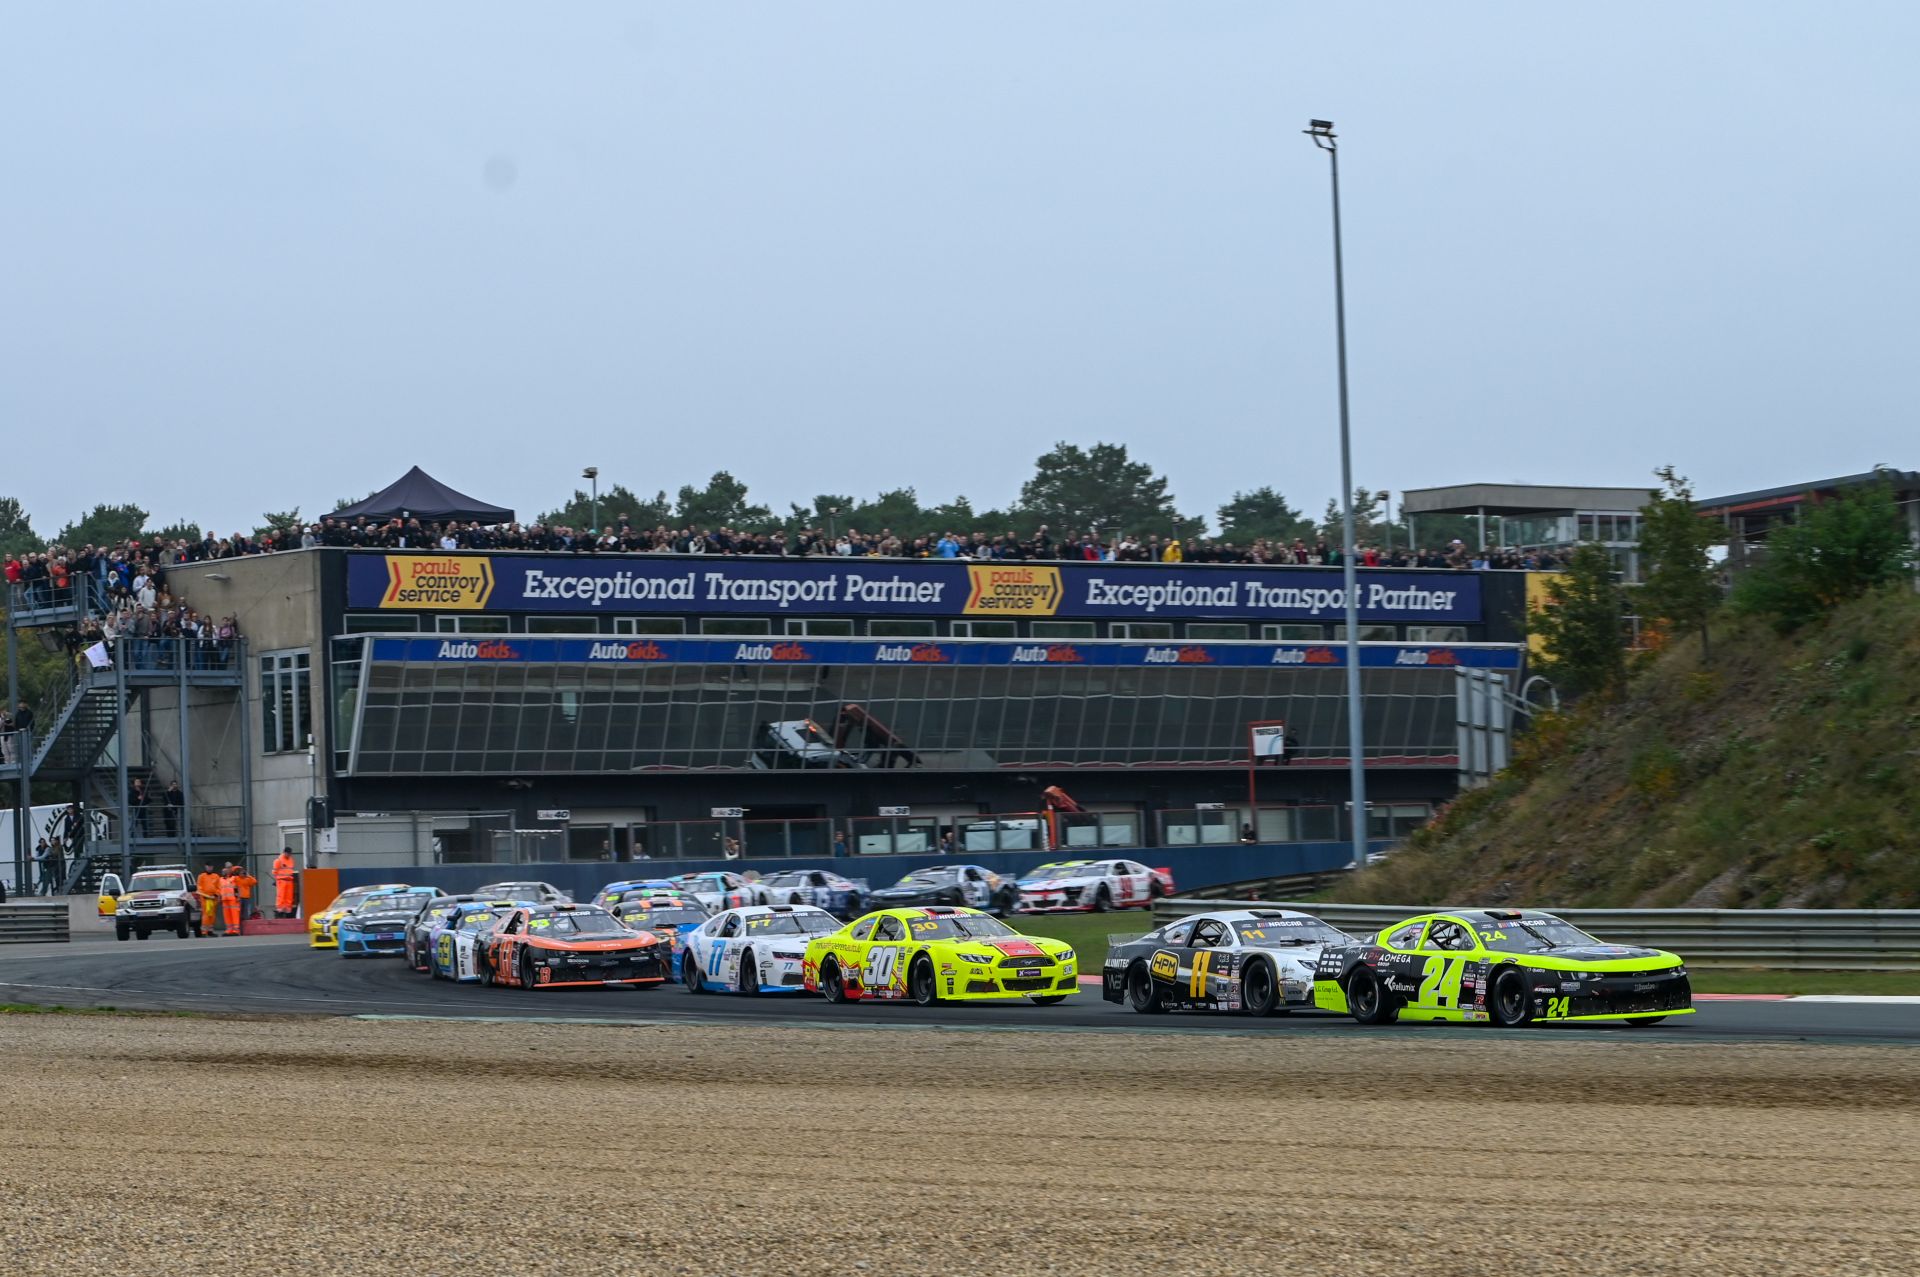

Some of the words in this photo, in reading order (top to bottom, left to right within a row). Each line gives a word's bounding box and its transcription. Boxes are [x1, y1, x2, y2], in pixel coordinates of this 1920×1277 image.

[411, 559, 460, 579] pauls
[989, 569, 1033, 587] pauls
[415, 573, 480, 595] convoy
[522, 569, 695, 605] Exceptional
[705, 572, 838, 608] Transport
[843, 575, 945, 603] Partner
[993, 582, 1050, 601] convoy
[398, 586, 461, 603] service
[978, 594, 1034, 609] service
[1085, 578, 1237, 612] Exceptional
[1366, 584, 1456, 610] Partner
[747, 919, 771, 928] 77
[911, 922, 938, 932] 30
[1241, 930, 1265, 938] 11
[1479, 931, 1507, 942] 24
[709, 940, 726, 976] 77
[864, 946, 897, 986] 30
[1154, 955, 1177, 974] HPM
[1357, 951, 1411, 963] ALPHAOMEGA
[1190, 951, 1212, 997] 11
[1418, 956, 1466, 1009] 24
[1547, 996, 1570, 1018] 24
